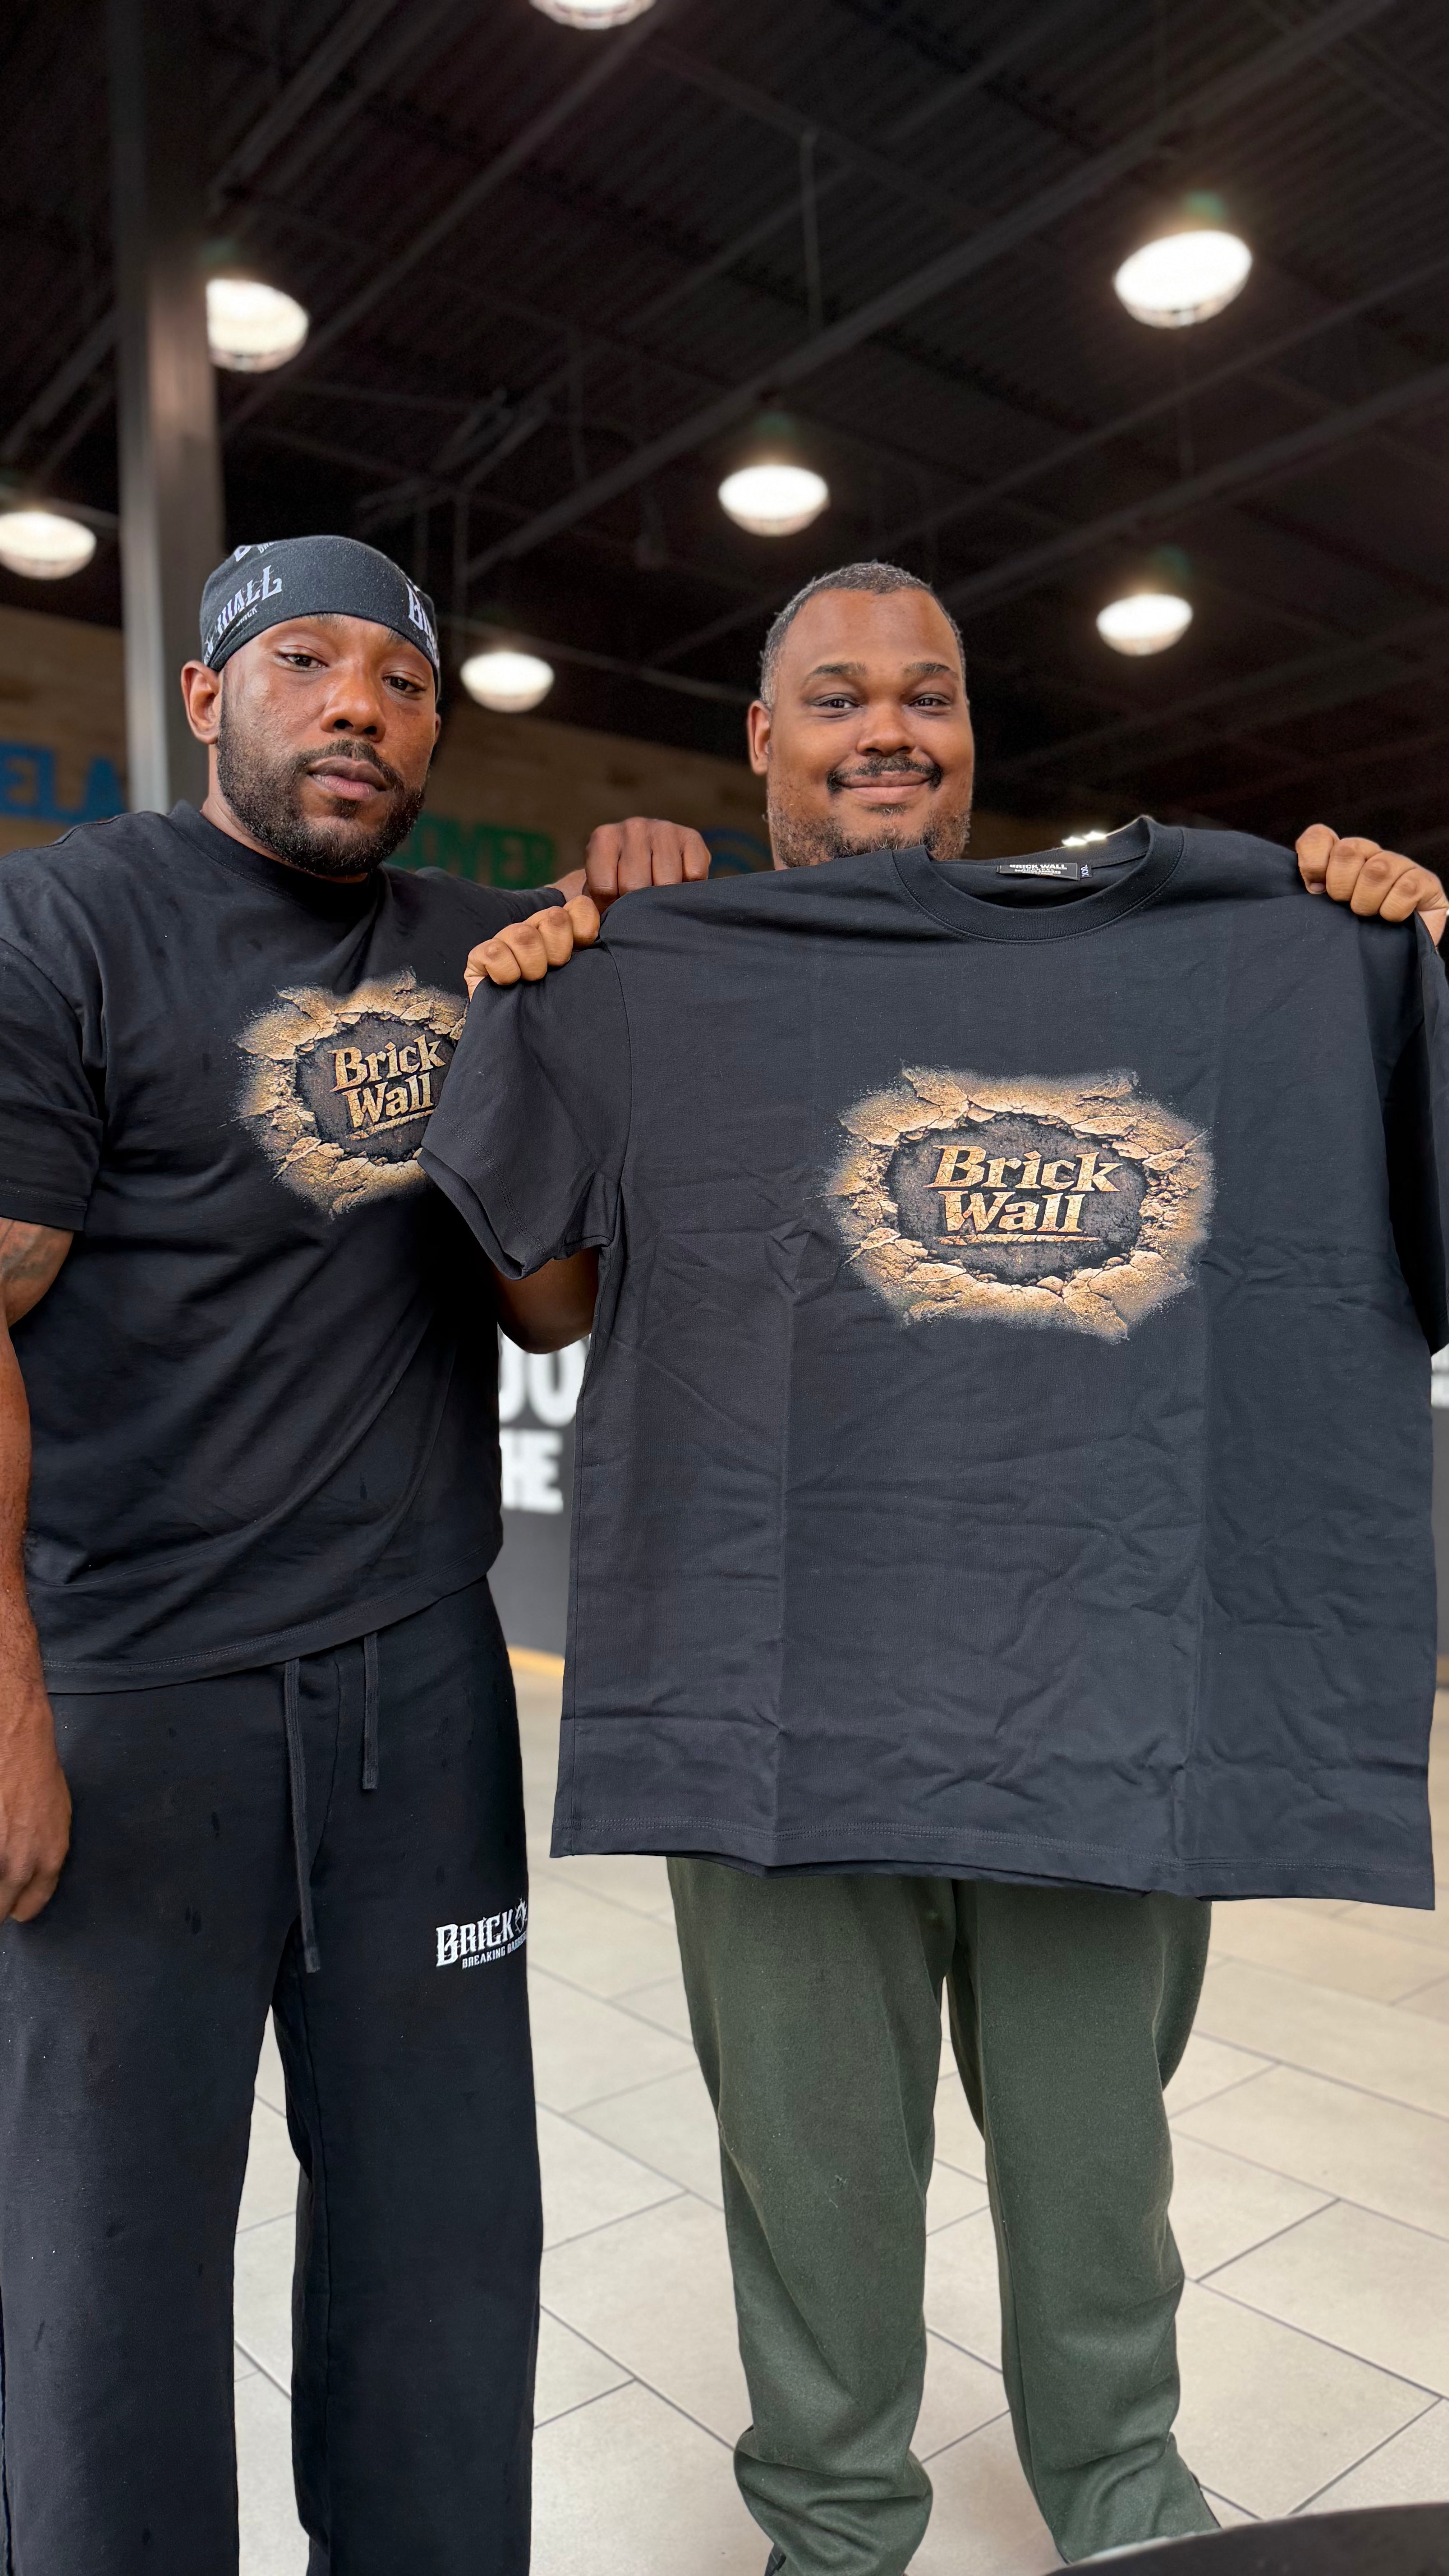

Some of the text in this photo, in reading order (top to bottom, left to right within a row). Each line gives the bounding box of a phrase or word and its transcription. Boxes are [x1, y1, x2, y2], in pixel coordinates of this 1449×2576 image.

[327, 1034, 446, 1093] Brick
[341, 1072, 434, 1128] Wall
[924, 1144, 1123, 1192] Brick
[937, 1190, 1087, 1233] Wall
[436, 1909, 514, 1968] BRICK
[461, 1946, 506, 1970] BREAKING
